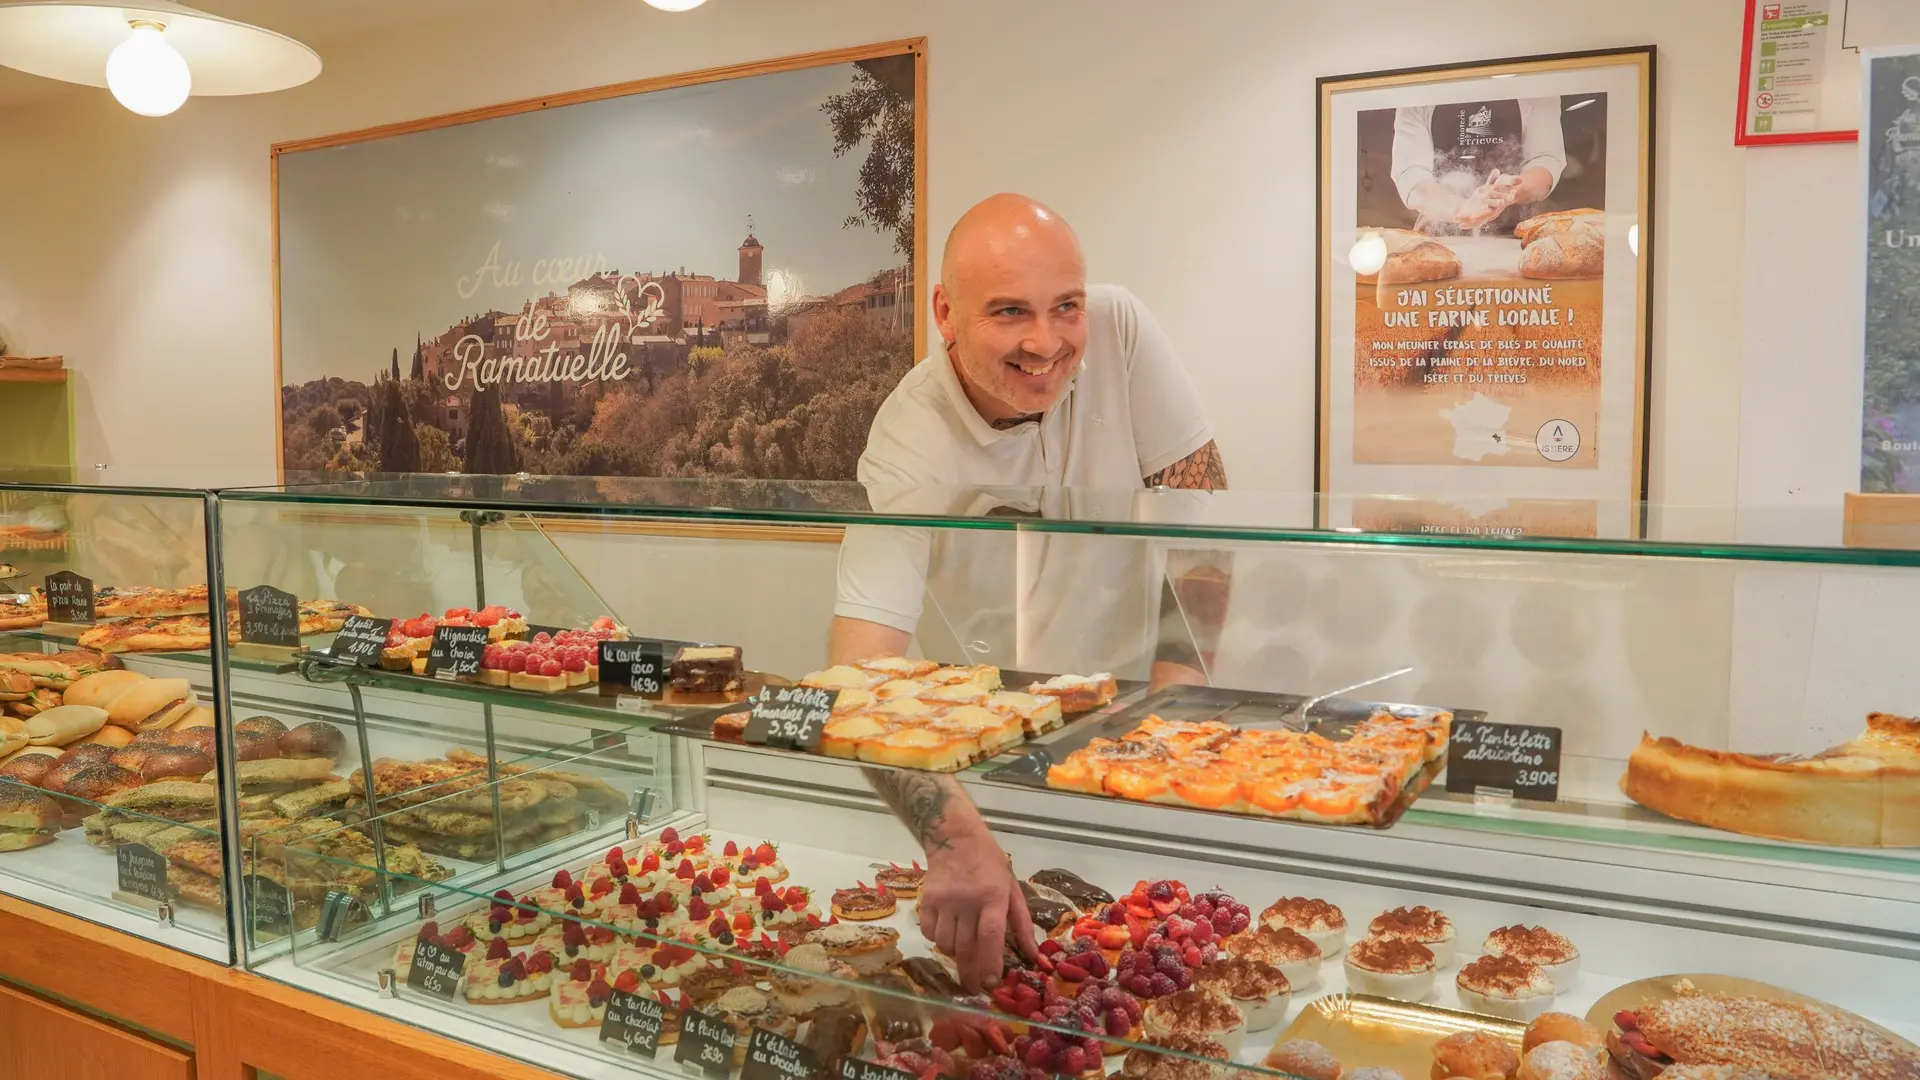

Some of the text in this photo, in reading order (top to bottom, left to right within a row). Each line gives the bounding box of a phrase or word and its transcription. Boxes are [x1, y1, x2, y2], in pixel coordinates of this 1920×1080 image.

[457, 239, 524, 299] Au
[1397, 283, 1553, 307] J'AI SÉLECTIONNÉ
[515, 292, 552, 341] de
[1384, 307, 1575, 328] UNE FARINE LOCALE !
[1372, 341, 1394, 351] MON
[1397, 340, 1439, 351] MEUNIER
[1443, 338, 1476, 350] ÉCRASE
[1479, 340, 1493, 350] DE
[1525, 340, 1538, 350] DE
[1541, 337, 1584, 350] QUALITÉ
[445, 323, 631, 392] Ramatuelle
[1369, 357, 1396, 367] ISSUS
[1399, 357, 1413, 367] DE
[1415, 357, 1426, 367] LA
[1430, 357, 1461, 367] PLAINE
[1466, 357, 1479, 367] DE
[1482, 357, 1494, 367] LA
[1539, 357, 1555, 367] DU
[1558, 357, 1587, 367] NORD
[1424, 373, 1528, 384] ISÈRE ET DU TRIÈVES
[1882, 440, 1920, 451] Boul
[439, 627, 487, 648] Mignardise
[431, 648, 444, 657] au
[631, 663, 654, 674] coco
[440, 953, 450, 963] au
[608, 1010, 621, 1022] au
[698, 1019, 719, 1041] Paris
[753, 1050, 767, 1064] au
